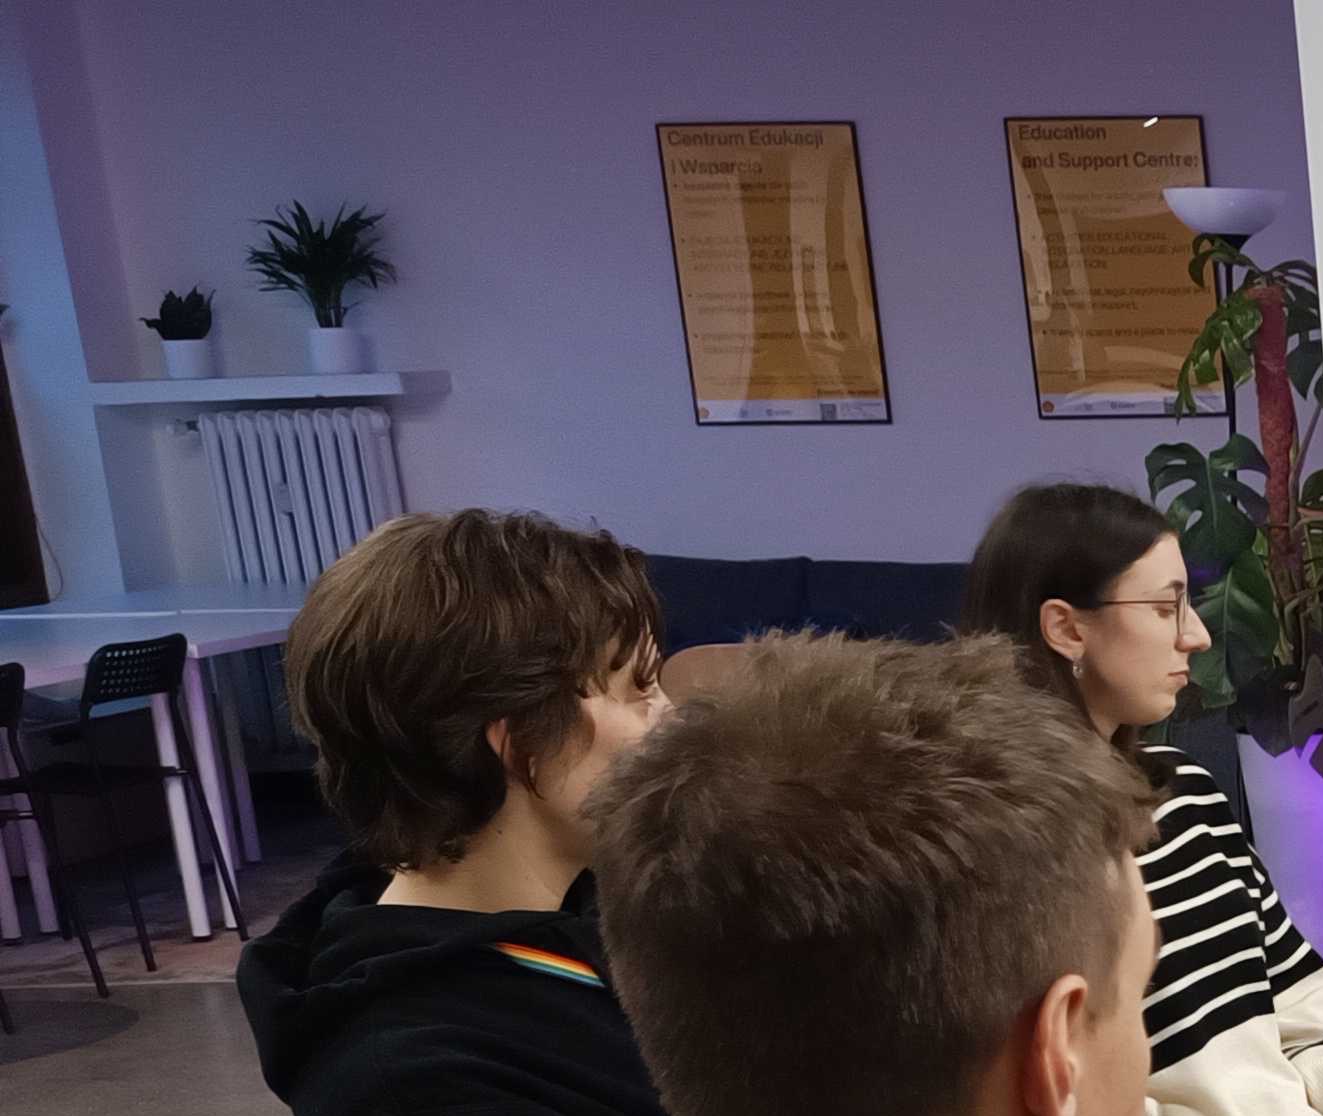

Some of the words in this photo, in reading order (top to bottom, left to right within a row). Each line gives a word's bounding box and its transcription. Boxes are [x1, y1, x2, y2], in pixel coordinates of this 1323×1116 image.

[667, 130, 744, 147] Centrum
[749, 130, 824, 149] Edukacji
[1018, 124, 1106, 141] Education
[681, 159, 763, 177] Wsparcia
[1021, 153, 1055, 169] and
[1058, 152, 1129, 172] Support
